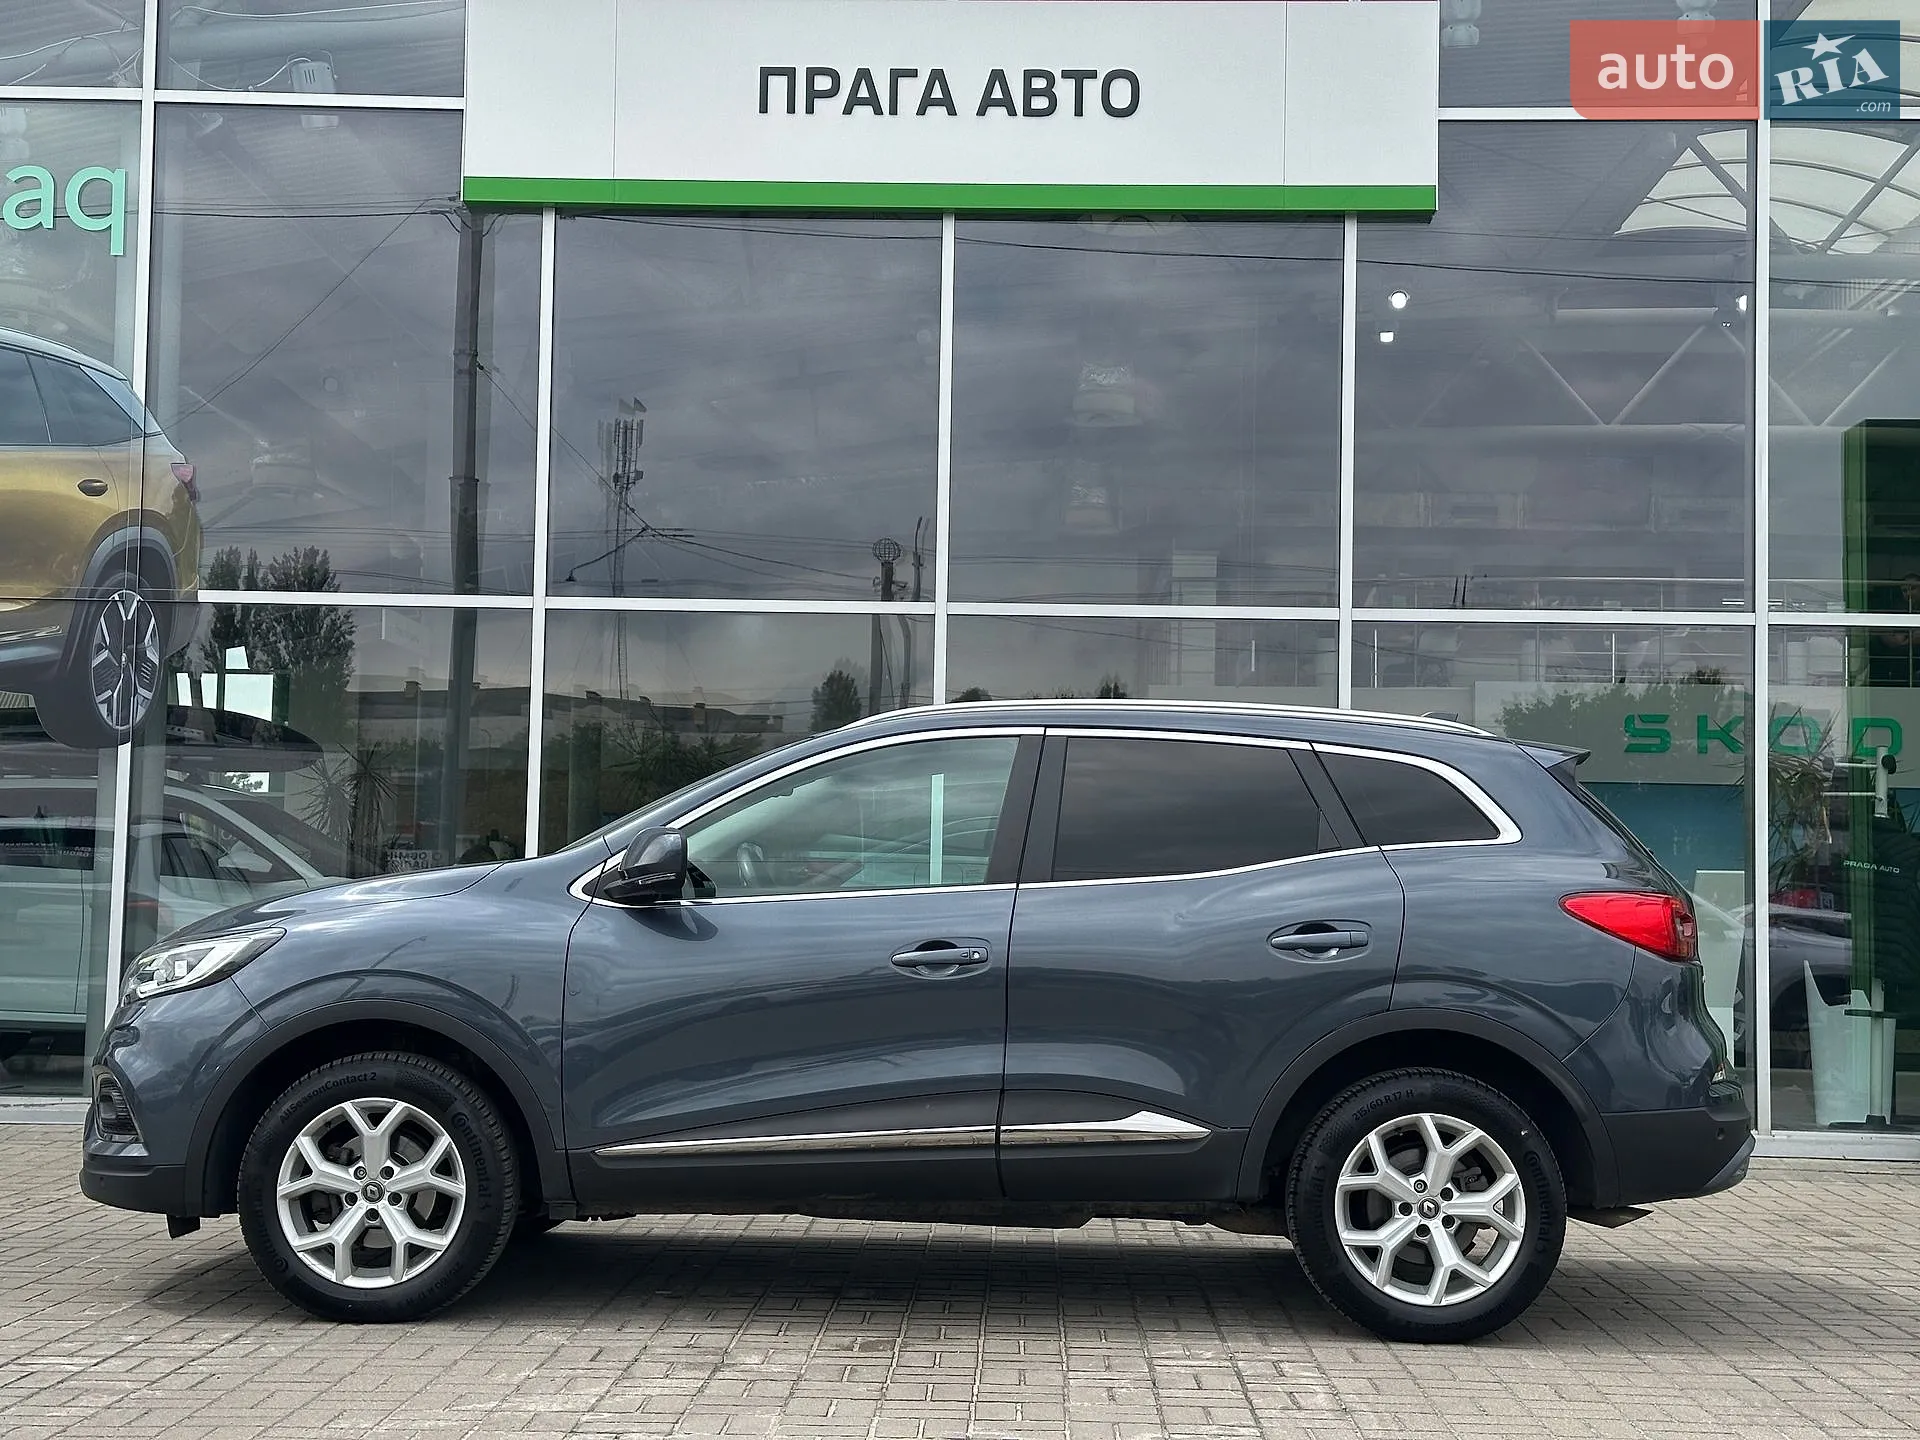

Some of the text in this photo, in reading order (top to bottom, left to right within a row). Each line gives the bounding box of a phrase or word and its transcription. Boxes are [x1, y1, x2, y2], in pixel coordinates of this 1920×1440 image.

[758, 66, 1141, 118] ПРАГА АВТО
[2, 164, 128, 257] aq
[452, 1111, 492, 1199] Continental
[1523, 1149, 1556, 1244] Continental
